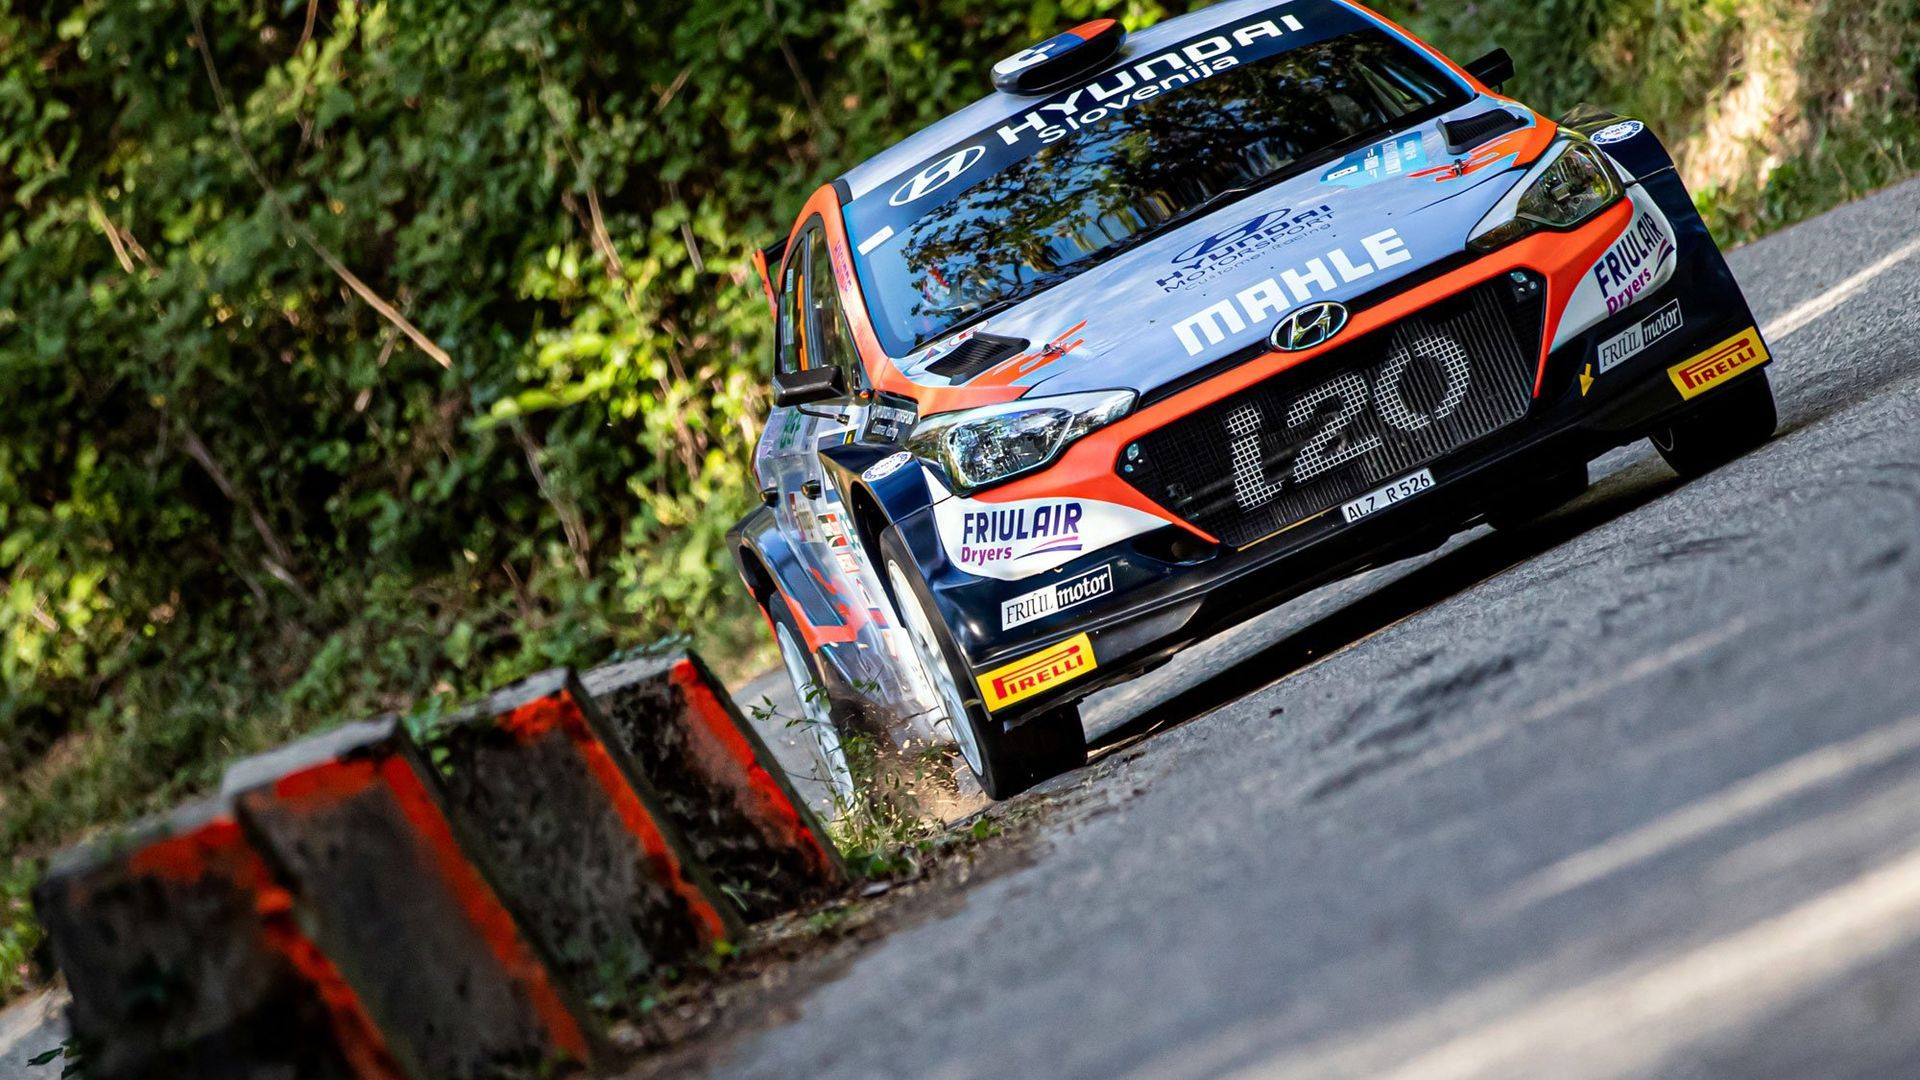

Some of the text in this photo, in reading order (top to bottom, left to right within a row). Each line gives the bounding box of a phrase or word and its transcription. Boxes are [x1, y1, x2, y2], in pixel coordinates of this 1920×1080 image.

[996, 14, 1304, 146] HYUNDAI
[1041, 56, 1240, 145] Slovenija
[1155, 205, 1331, 287] HYUNDAI
[1164, 211, 1335, 293] MOTORSPORT
[1593, 212, 1663, 298] FRIULAIR
[1171, 227, 1412, 357] MAHLE
[1605, 267, 1652, 316] Dryers
[1643, 307, 1678, 343] motor
[1678, 337, 1756, 390] PIRELLI
[962, 502, 1083, 545] FRIULAIR
[1347, 496, 1379, 520] ALZ
[1399, 473, 1430, 496] 526
[961, 546, 1012, 566] Dryers
[1057, 572, 1108, 607] motor
[992, 645, 1084, 700] PIRELLI
